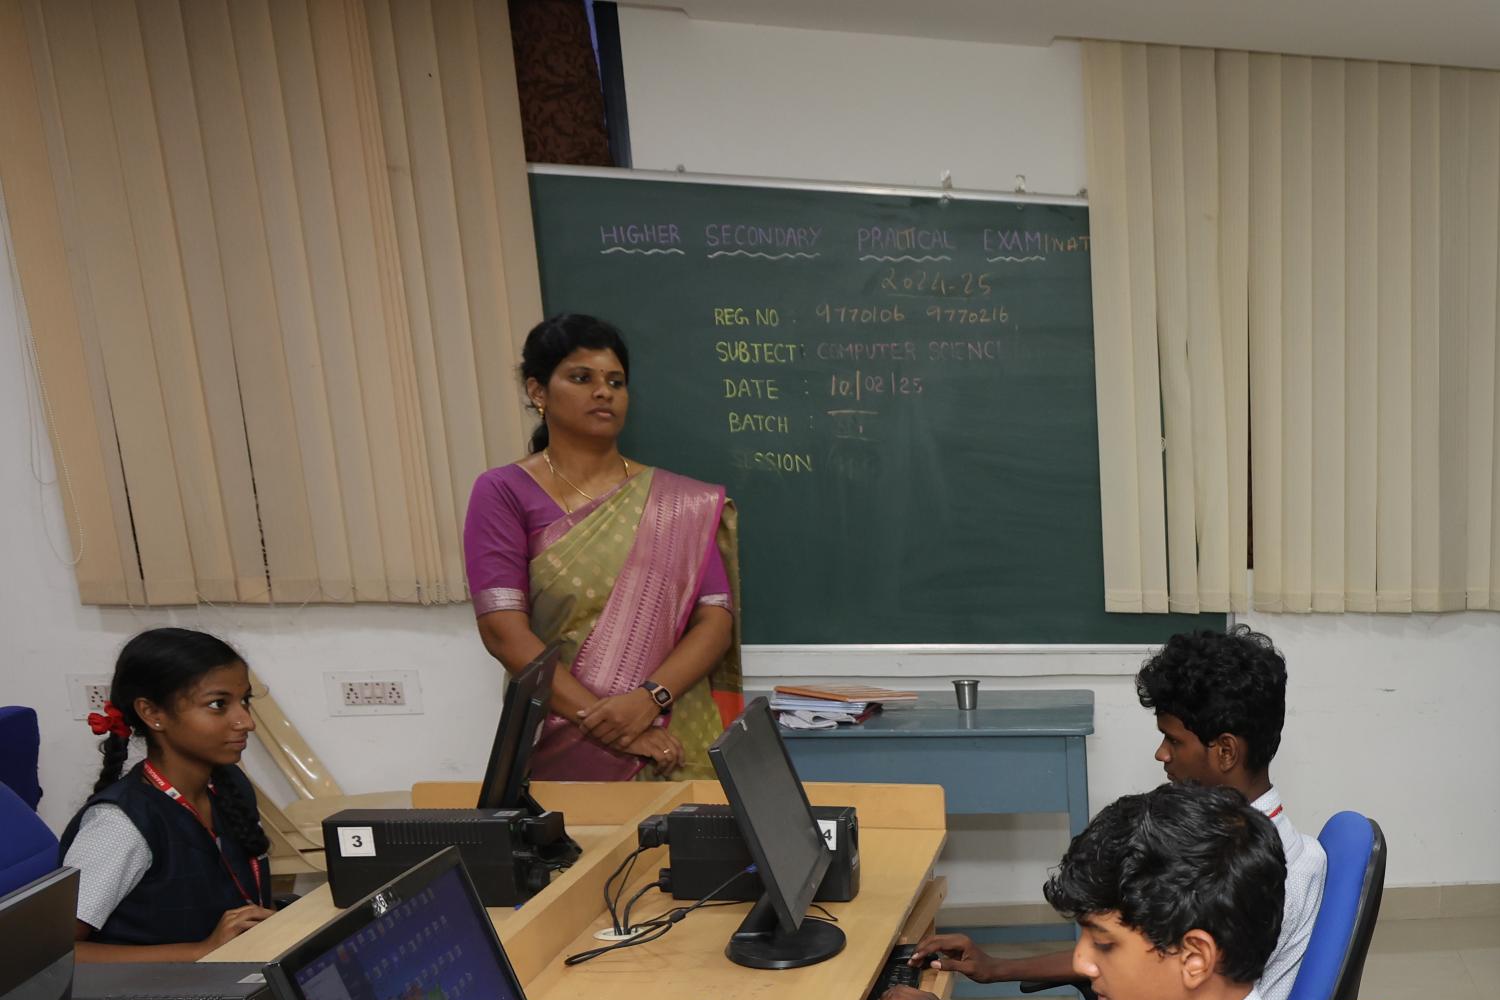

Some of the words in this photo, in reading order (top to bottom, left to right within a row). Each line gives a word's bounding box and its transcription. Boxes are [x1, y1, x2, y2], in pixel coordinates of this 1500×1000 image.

[600, 223, 681, 244] HIGHER
[704, 224, 823, 247] SECONDARY
[714, 308, 750, 326] REG
[816, 341, 916, 361] COMPUTER
[723, 378, 780, 400] DATE
[728, 411, 789, 434] BATCH
[351, 834, 363, 848] 3
[822, 828, 833, 841] 4
